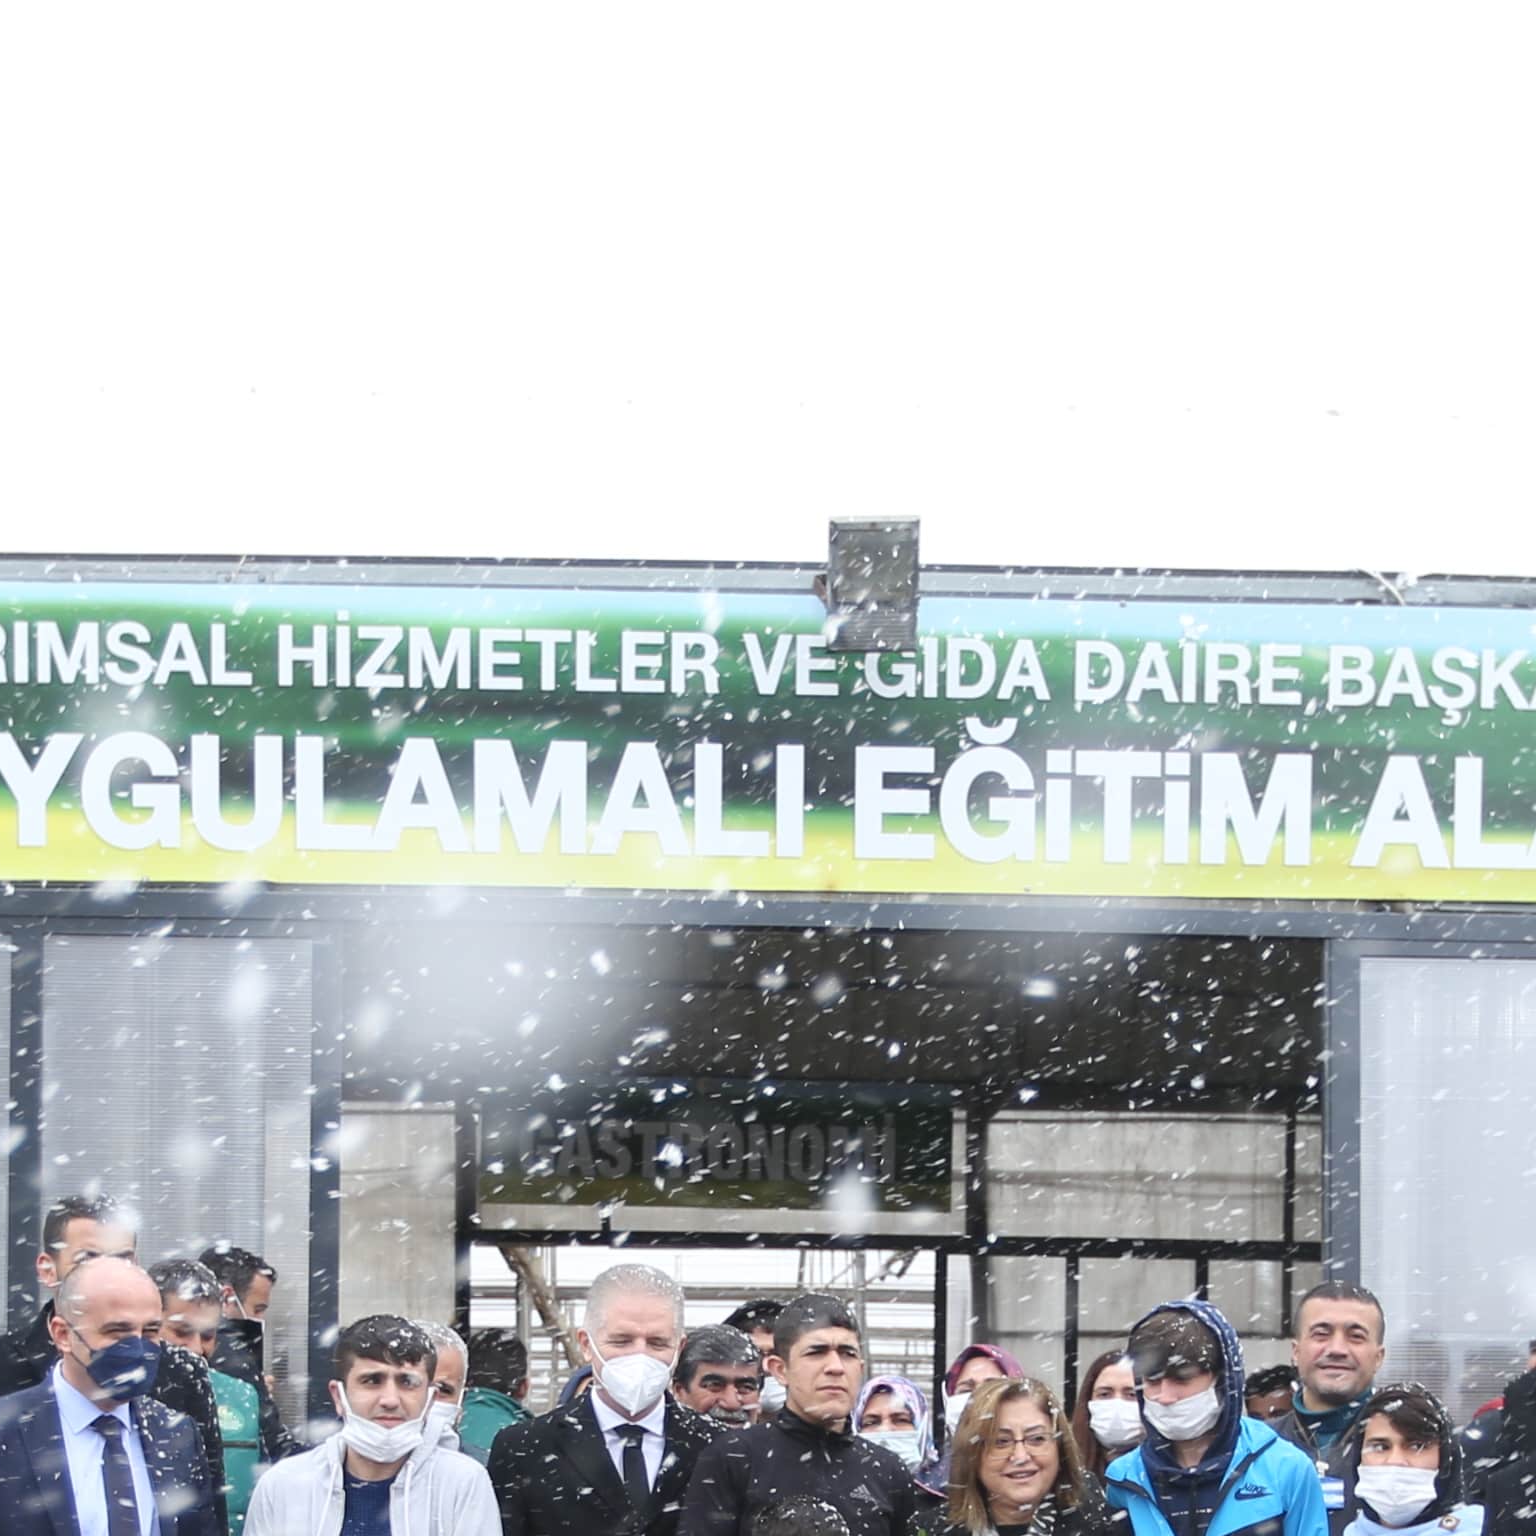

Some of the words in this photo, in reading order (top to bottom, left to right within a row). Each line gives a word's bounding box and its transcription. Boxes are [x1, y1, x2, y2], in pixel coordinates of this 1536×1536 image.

[279, 609, 720, 696] HİZMETLER
[742, 632, 840, 697] VE
[864, 636, 1052, 702] GIDA
[1074, 630, 1304, 706] DAİRE
[854, 716, 1314, 868] EĞİTİM
